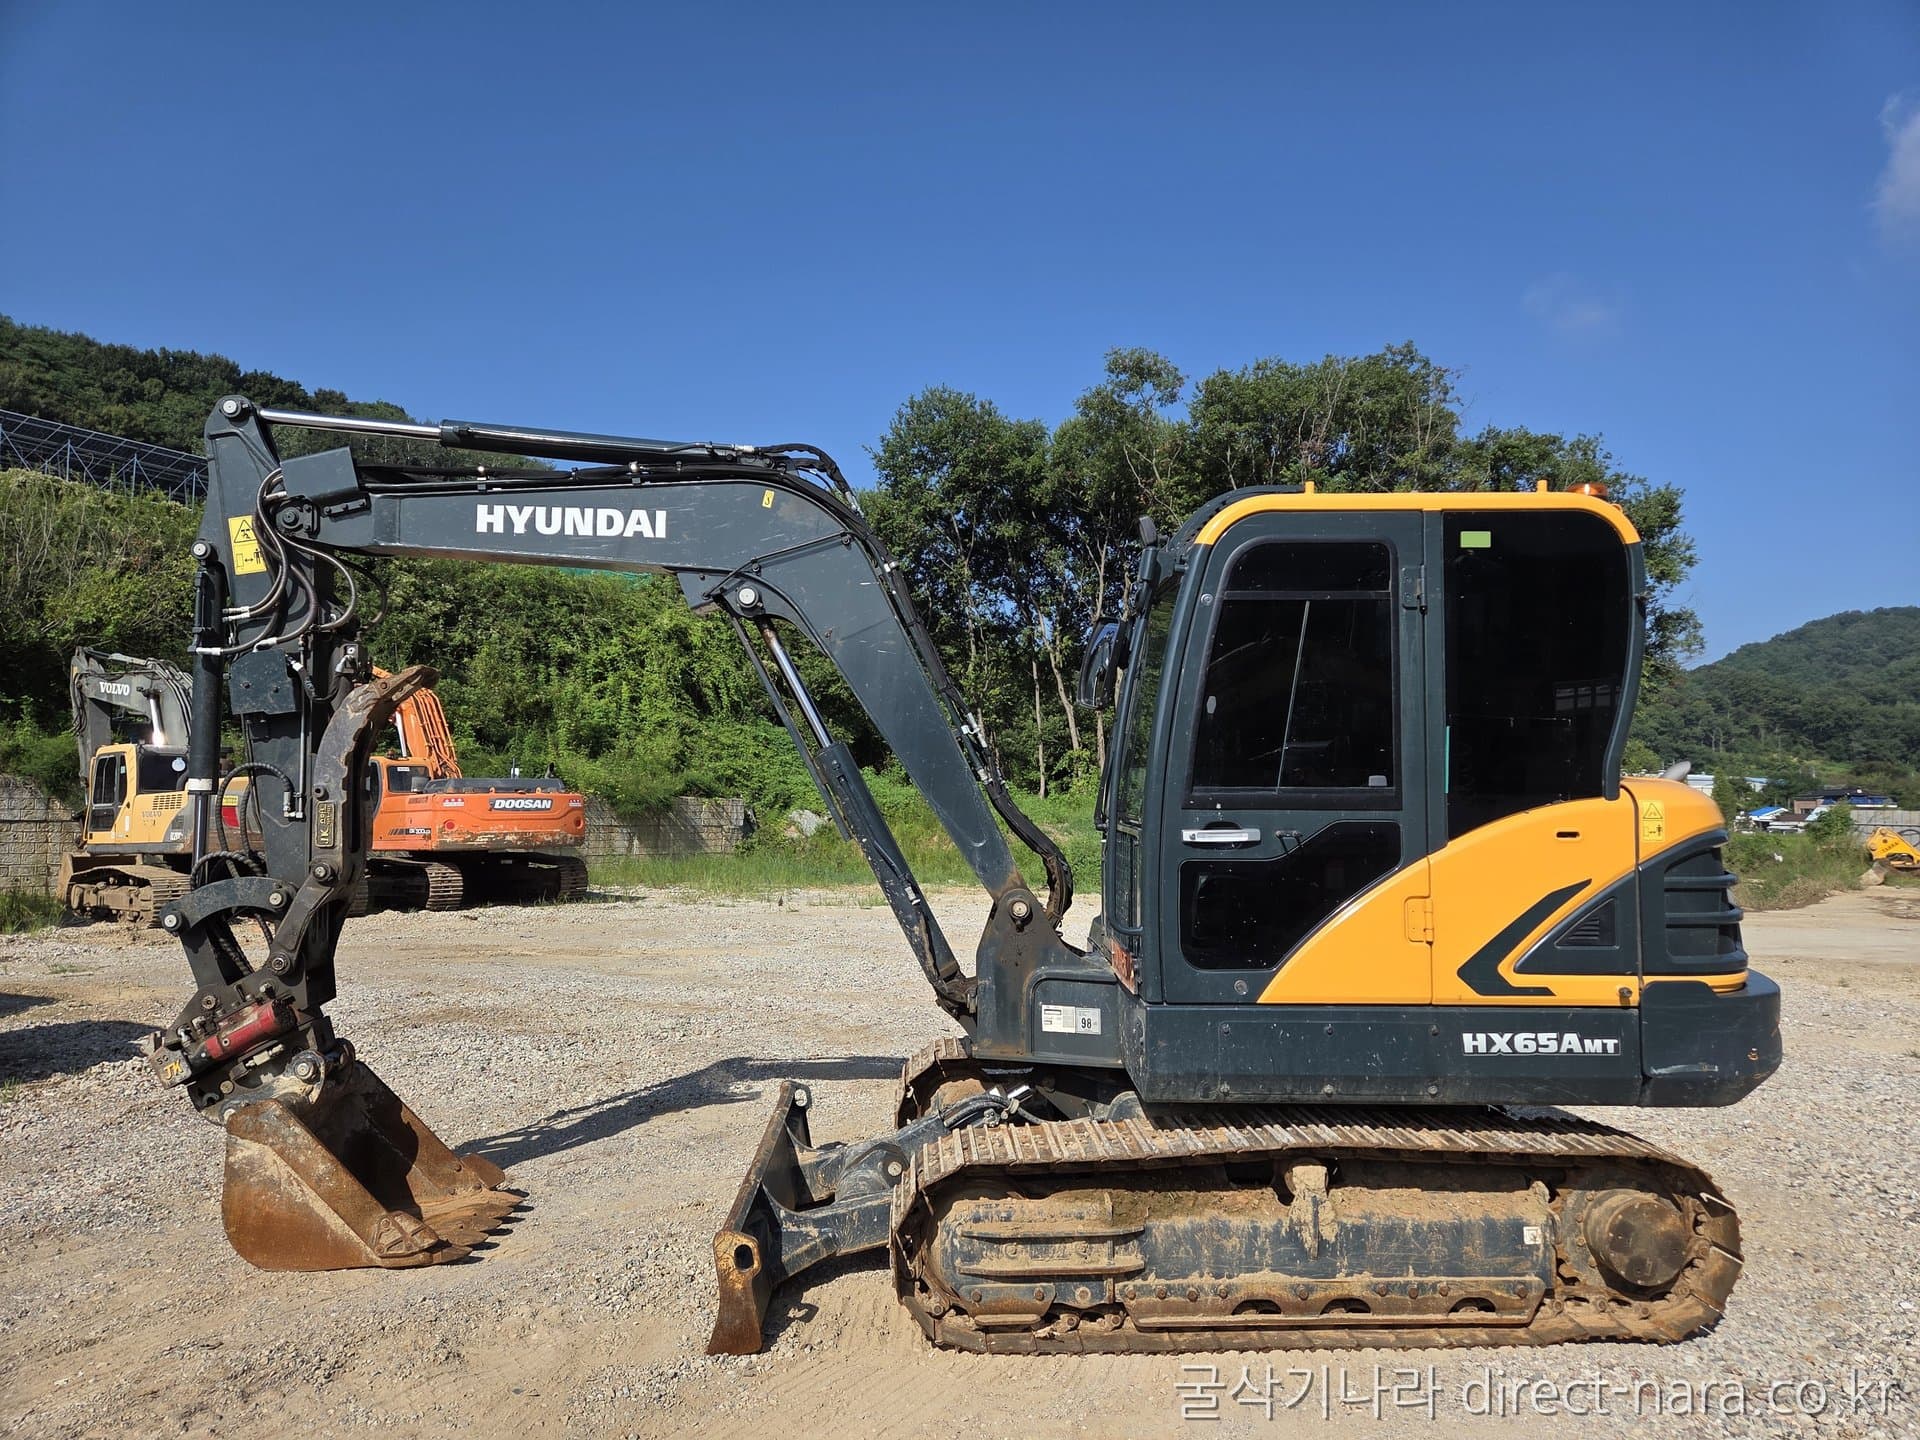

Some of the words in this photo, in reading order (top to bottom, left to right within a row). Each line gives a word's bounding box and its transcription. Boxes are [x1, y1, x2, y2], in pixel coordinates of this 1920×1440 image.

[475, 503, 667, 539] HYUNDAI
[100, 681, 131, 696] VOLVO
[493, 799, 552, 810] DOOSAN
[1081, 1017, 1092, 1029] 98
[1462, 1032, 1618, 1054] HX65AMT
